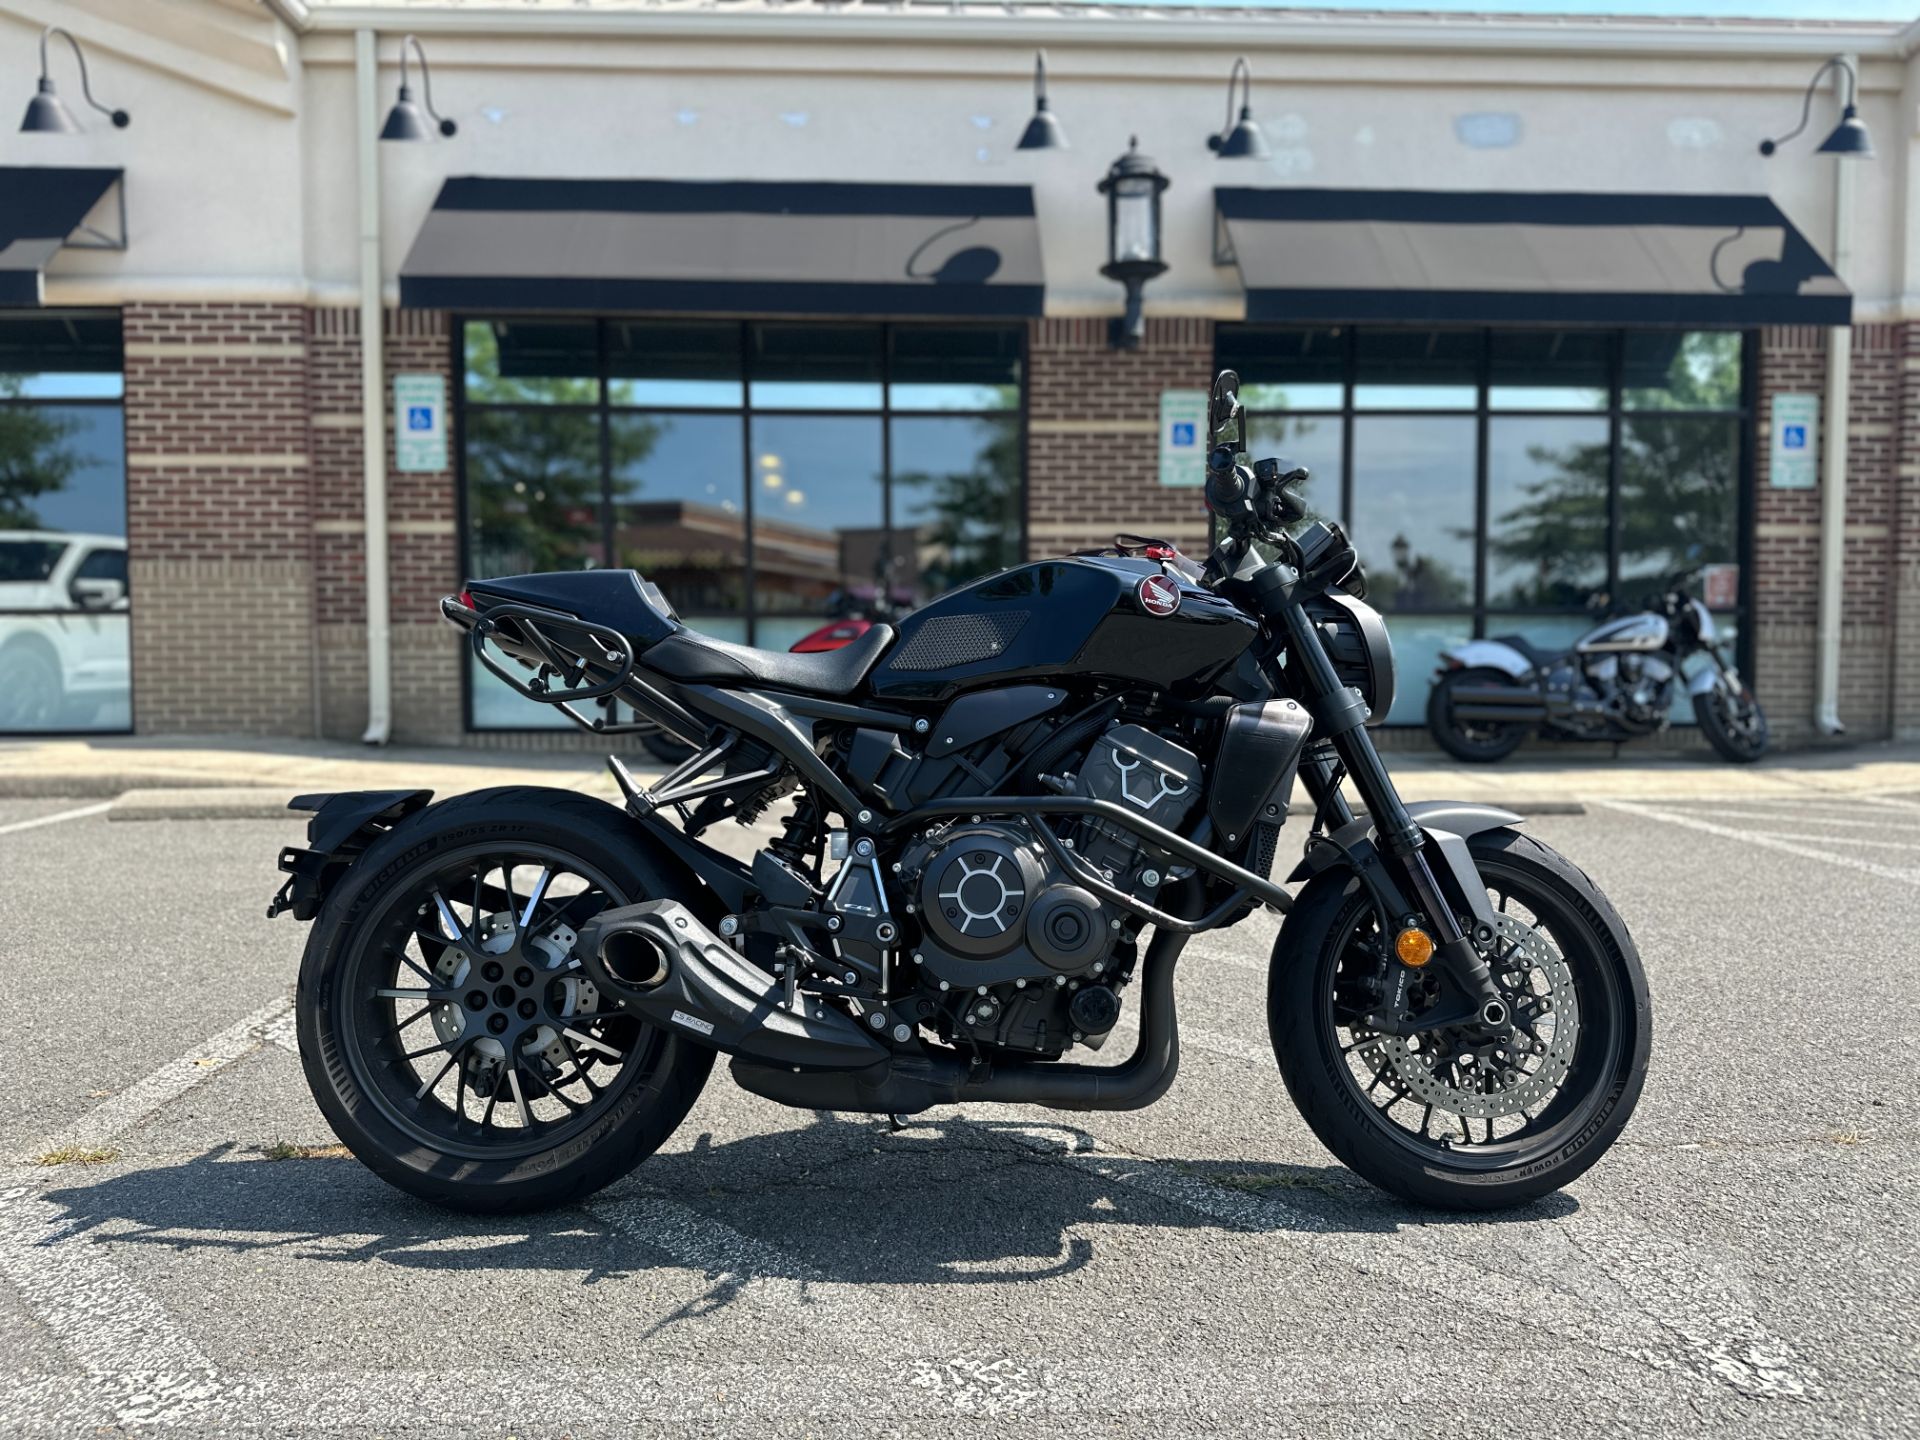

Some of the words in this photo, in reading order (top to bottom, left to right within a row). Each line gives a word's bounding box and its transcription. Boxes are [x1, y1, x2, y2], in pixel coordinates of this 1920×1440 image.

[1144, 597, 1173, 609] HONDA
[1393, 969, 1406, 1008] TOKICO
[674, 1011, 685, 1020] CS
[686, 1016, 712, 1030] RACING
[1565, 1098, 1613, 1157] MICHELIN
[1519, 1154, 1560, 1176] POWER
